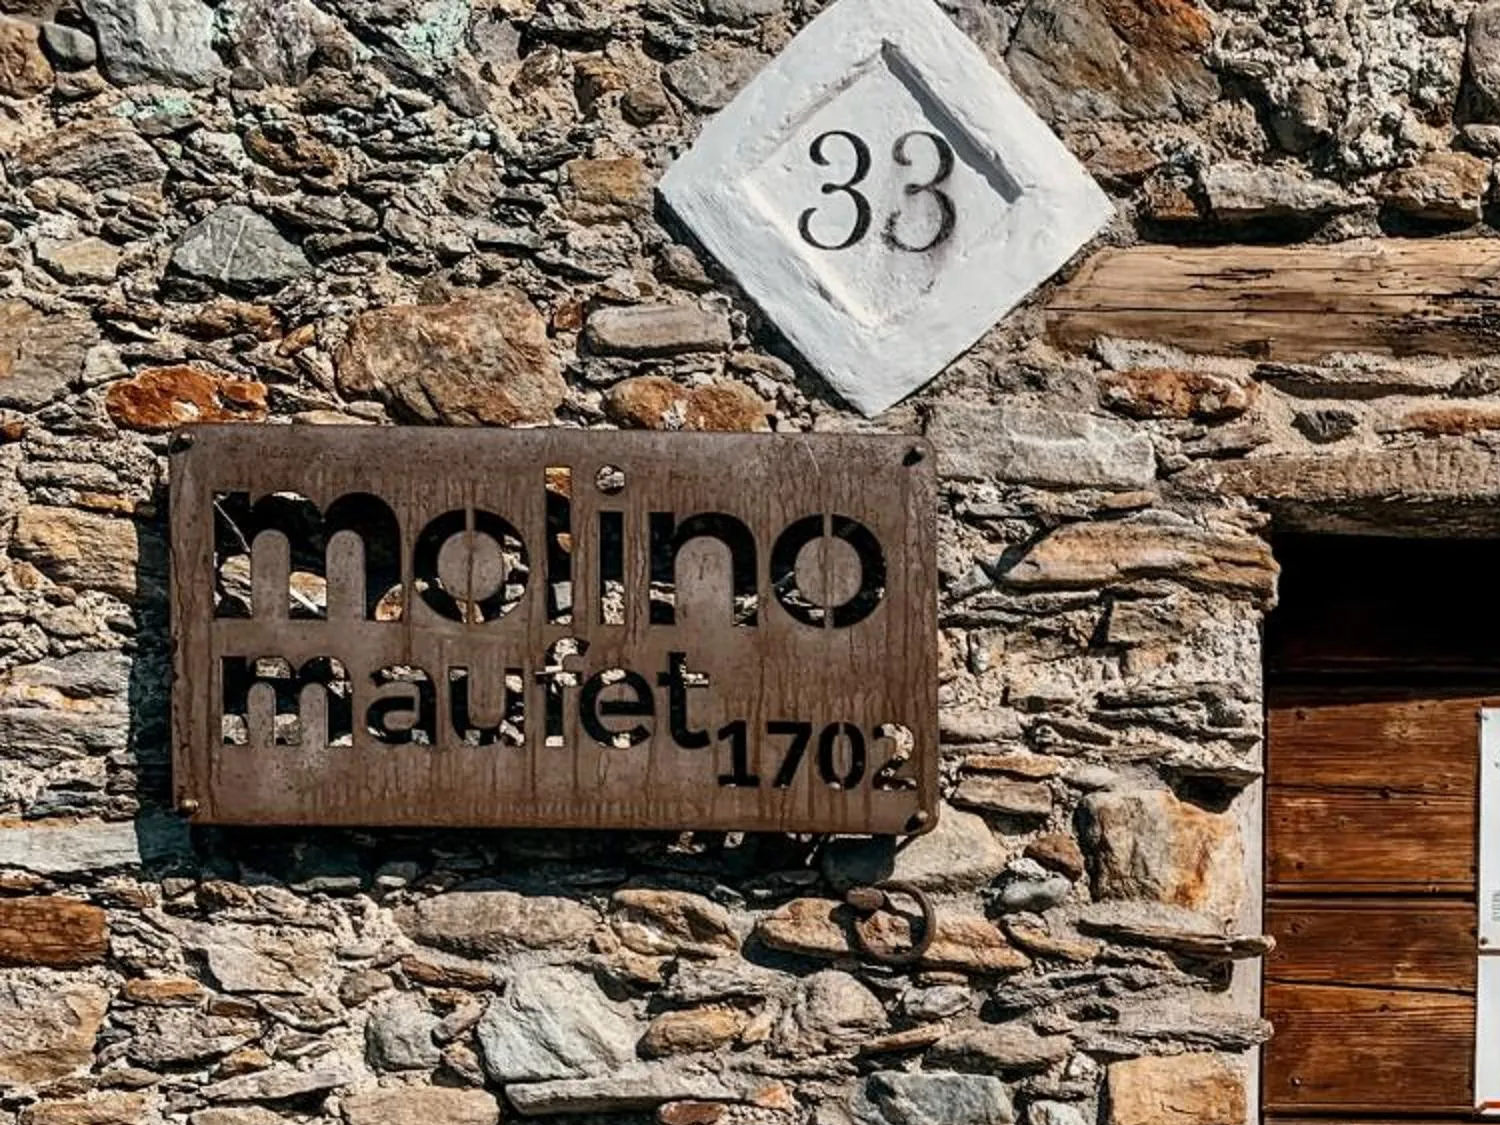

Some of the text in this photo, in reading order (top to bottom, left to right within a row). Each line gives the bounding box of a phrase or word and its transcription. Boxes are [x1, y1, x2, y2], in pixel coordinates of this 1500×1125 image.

[799, 130, 957, 252] 33
[213, 463, 888, 630] molino
[220, 636, 712, 750] maufet
[716, 720, 918, 791] 1702
